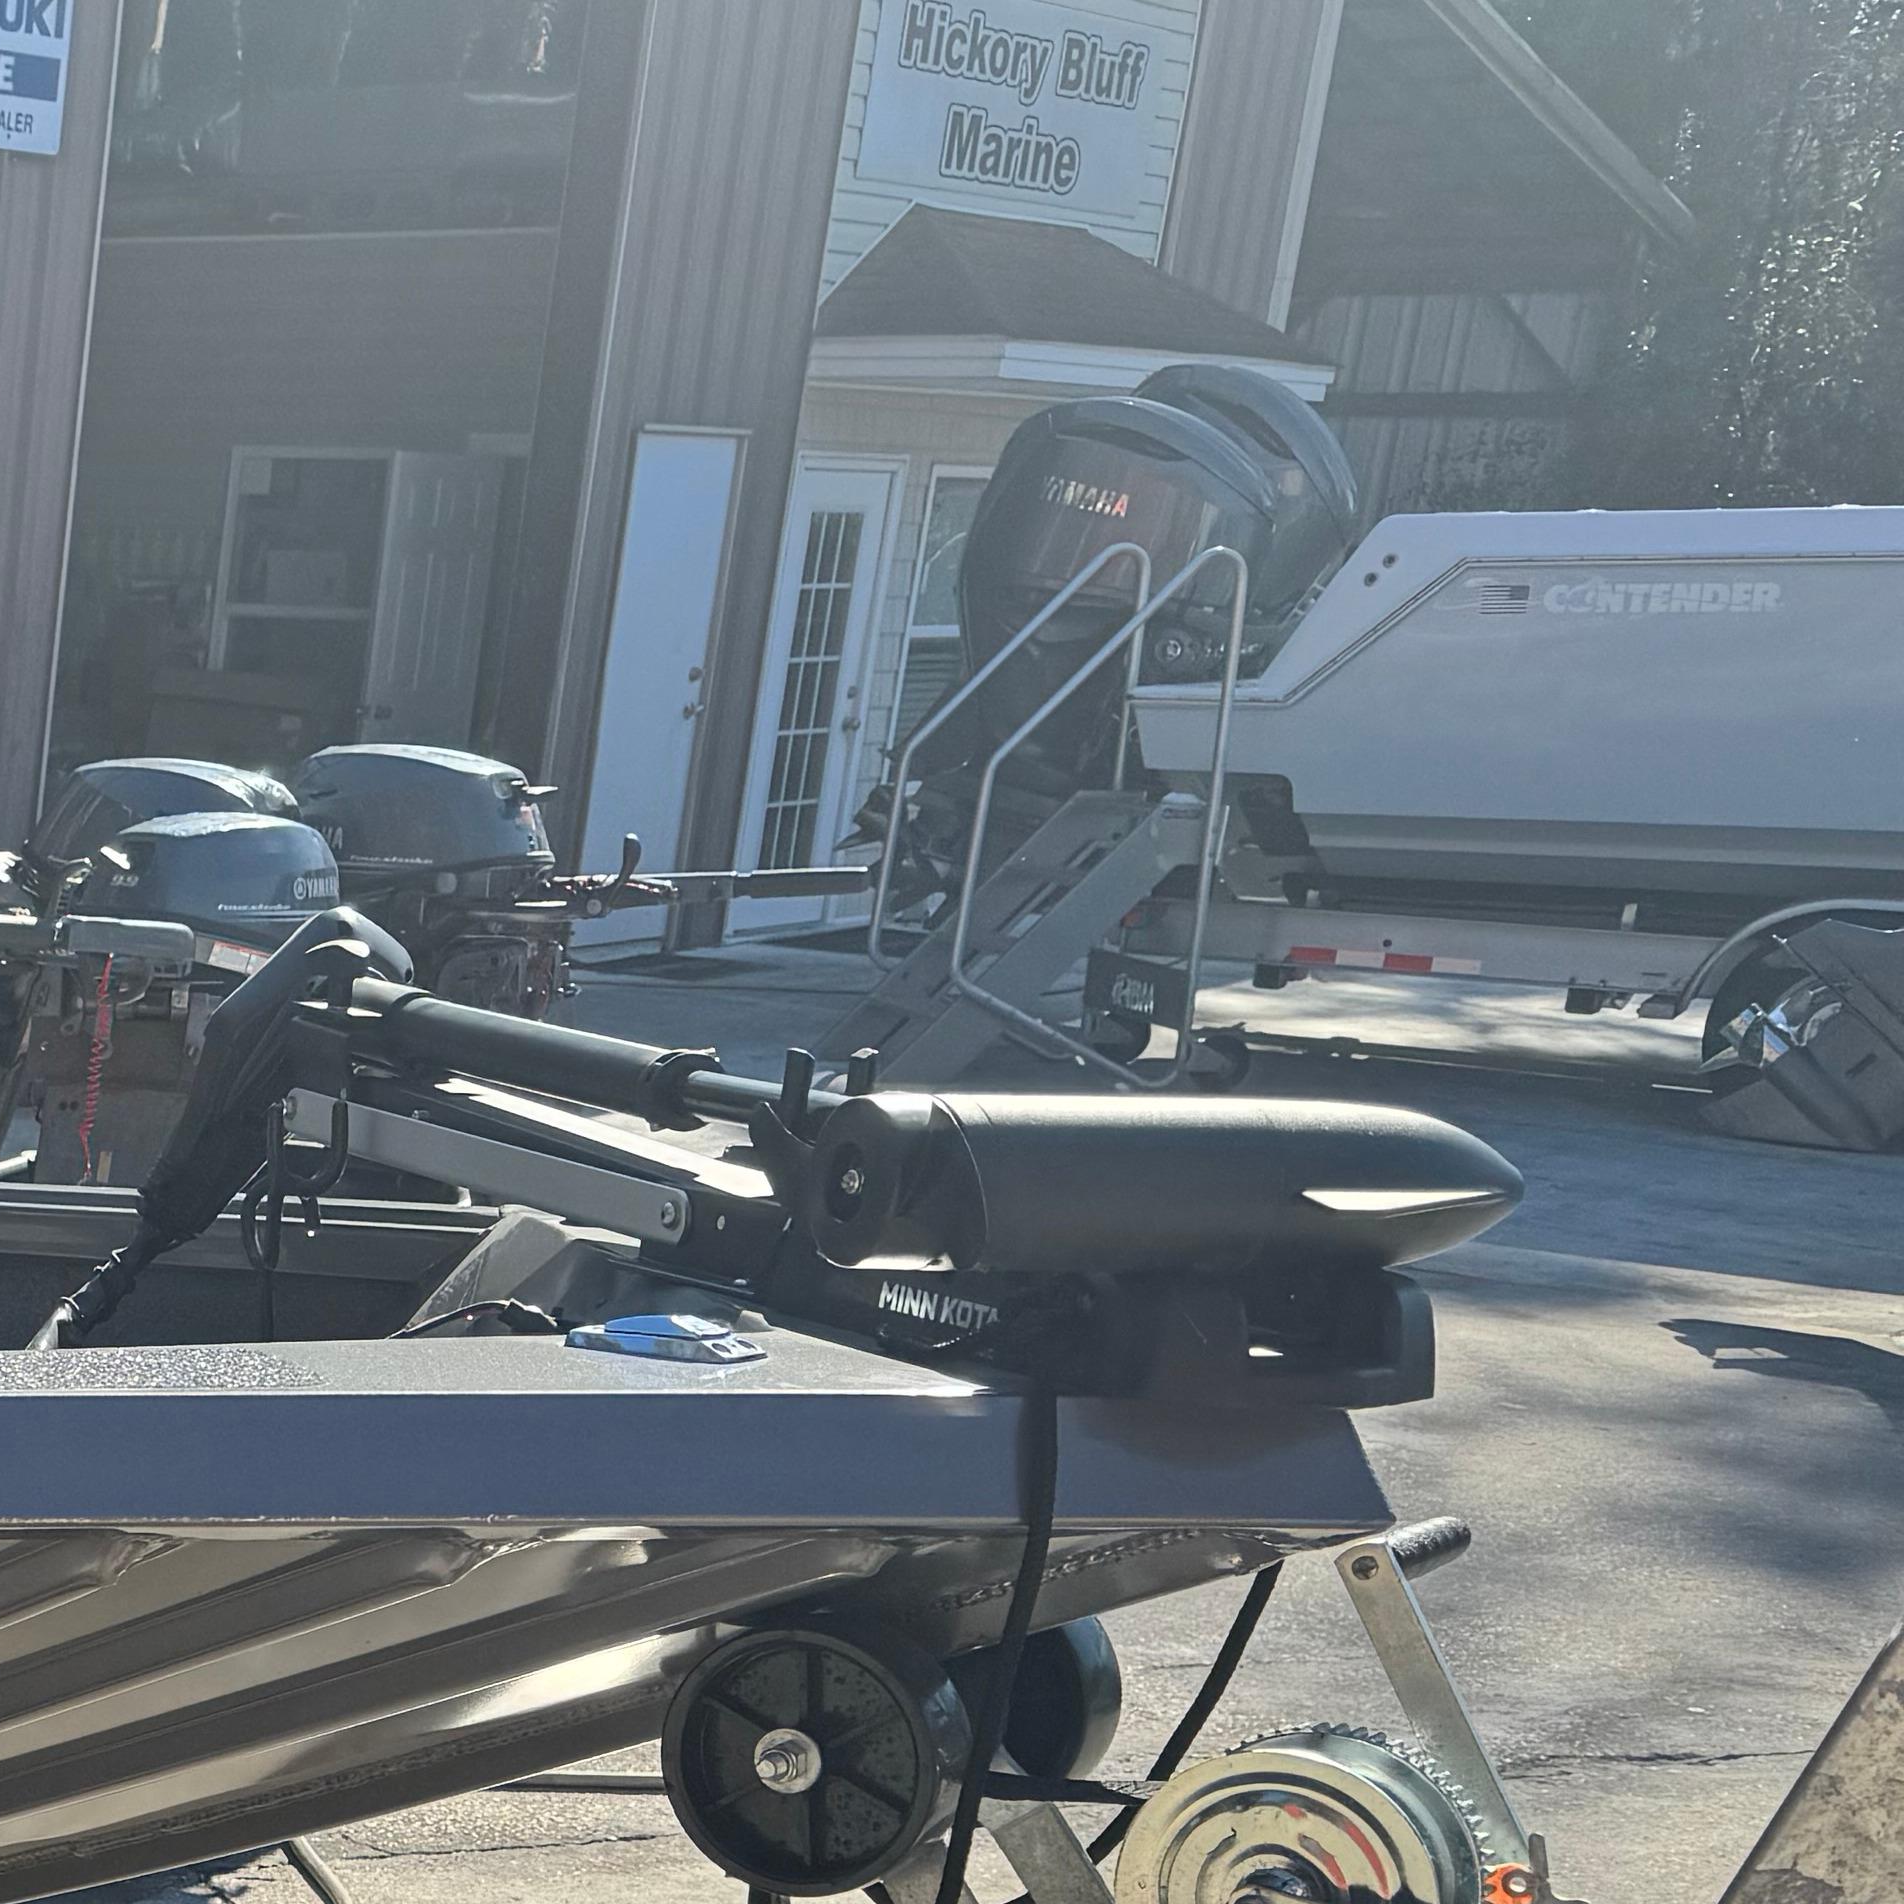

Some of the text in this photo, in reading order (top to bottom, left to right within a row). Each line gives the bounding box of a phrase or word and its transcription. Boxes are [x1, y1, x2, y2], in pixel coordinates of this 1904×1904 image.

[898, 0, 1149, 109] Hickory Bluff
[939, 103, 1080, 195] Marine
[1543, 582, 1784, 614] CONTENDER
[878, 1281, 999, 1330] MINN KOTA
